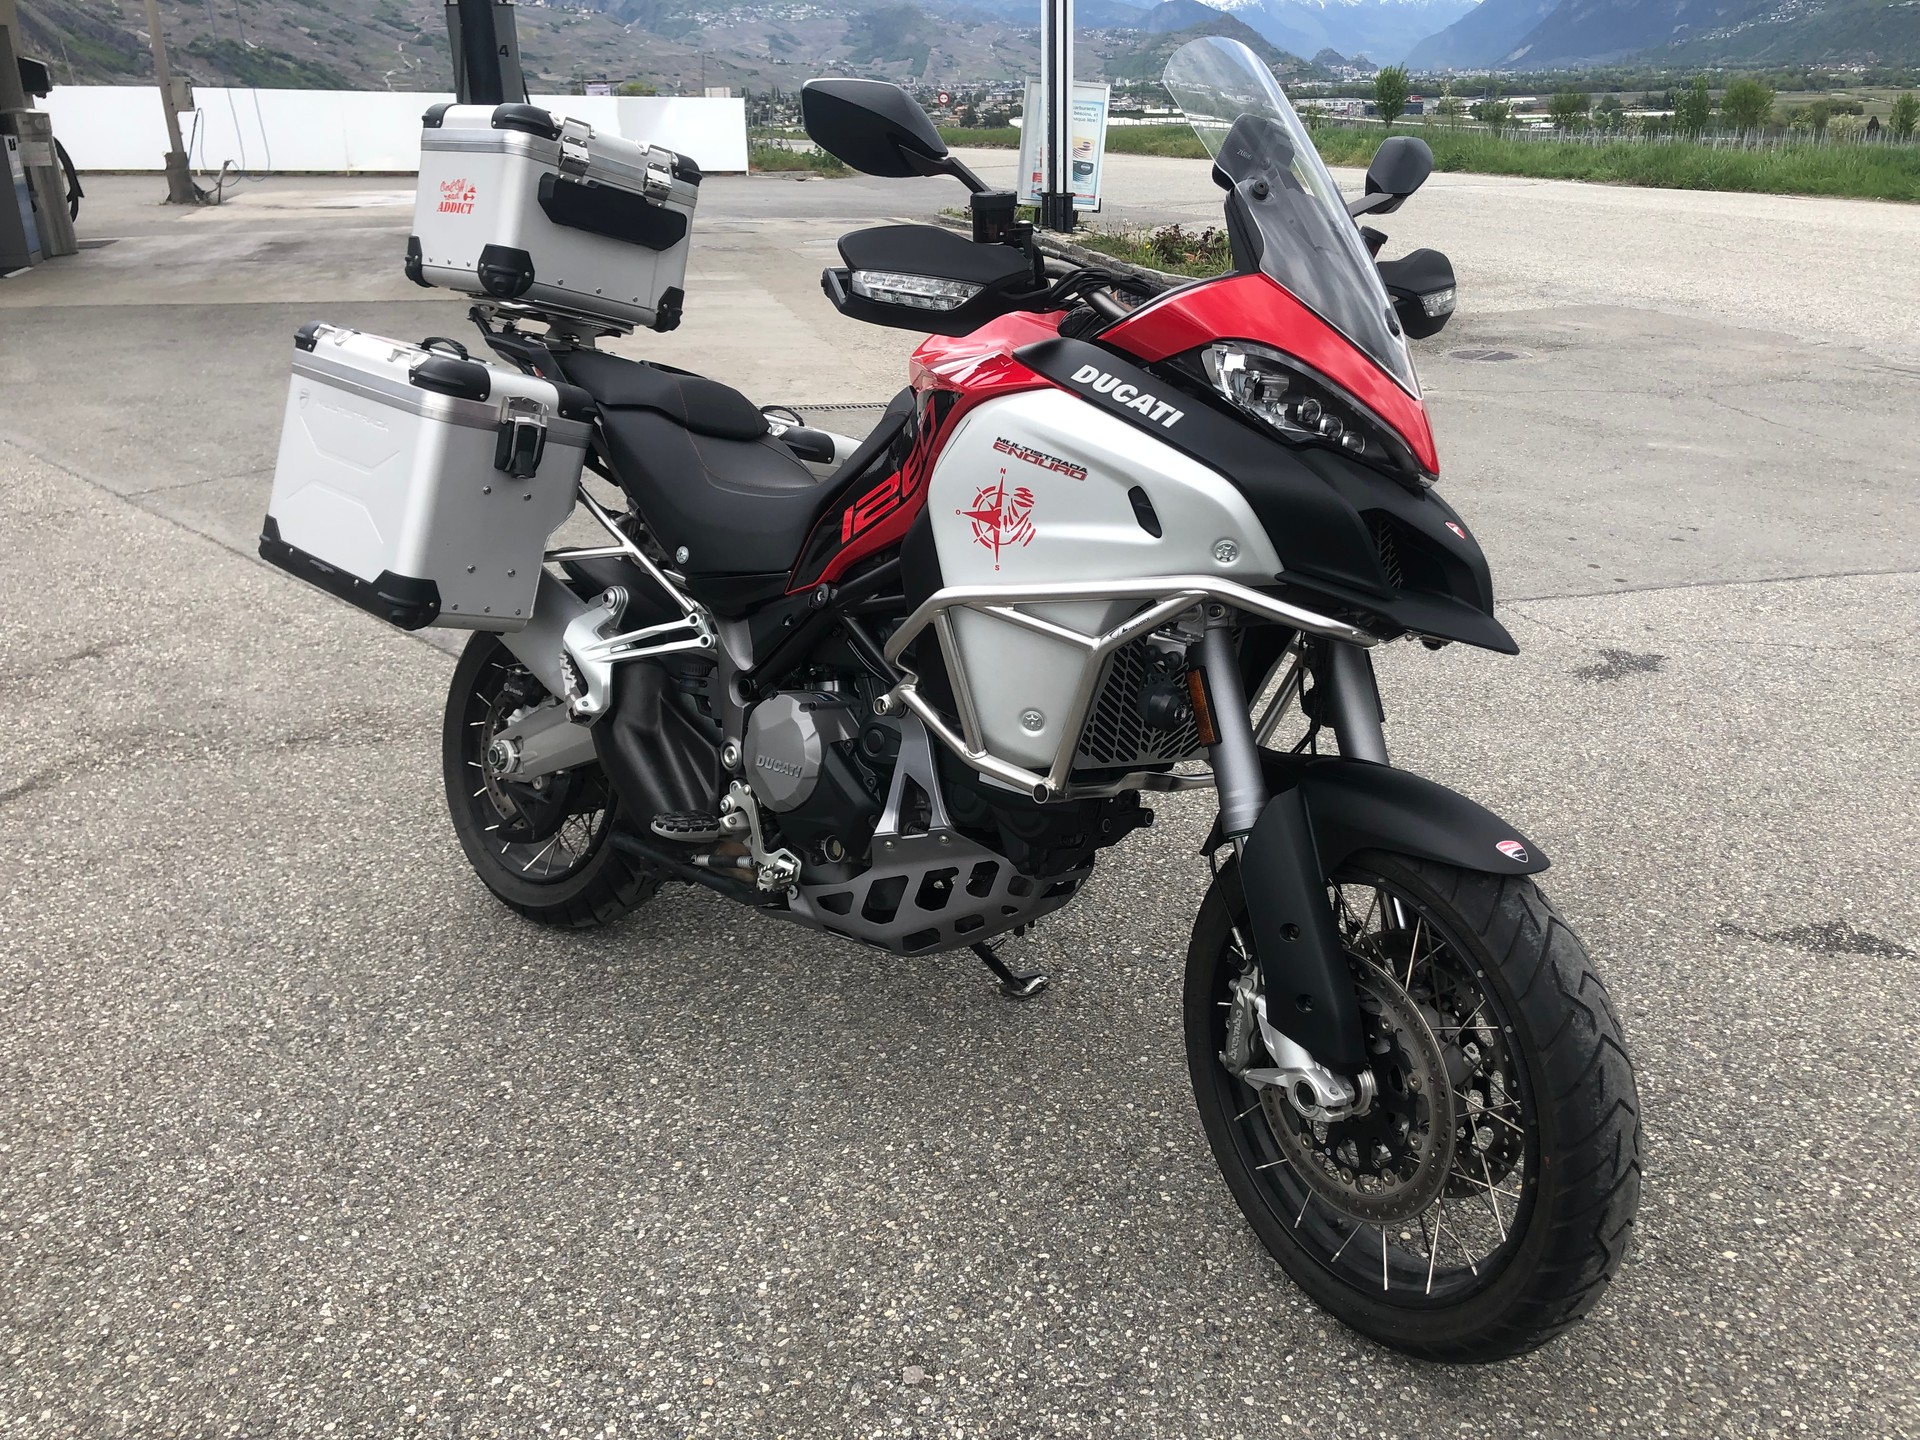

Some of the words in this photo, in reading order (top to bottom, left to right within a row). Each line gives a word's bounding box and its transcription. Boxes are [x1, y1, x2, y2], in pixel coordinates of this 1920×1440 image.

[499, 44, 509, 58] 4
[436, 201, 475, 215] ADDICT
[1070, 364, 1185, 428] DUCATI
[841, 395, 937, 544] 1260
[993, 441, 1089, 481] ENDURO
[996, 436, 1089, 474] MULTISTRADA
[1000, 467, 1007, 475] N
[756, 754, 802, 778] DUCATI
